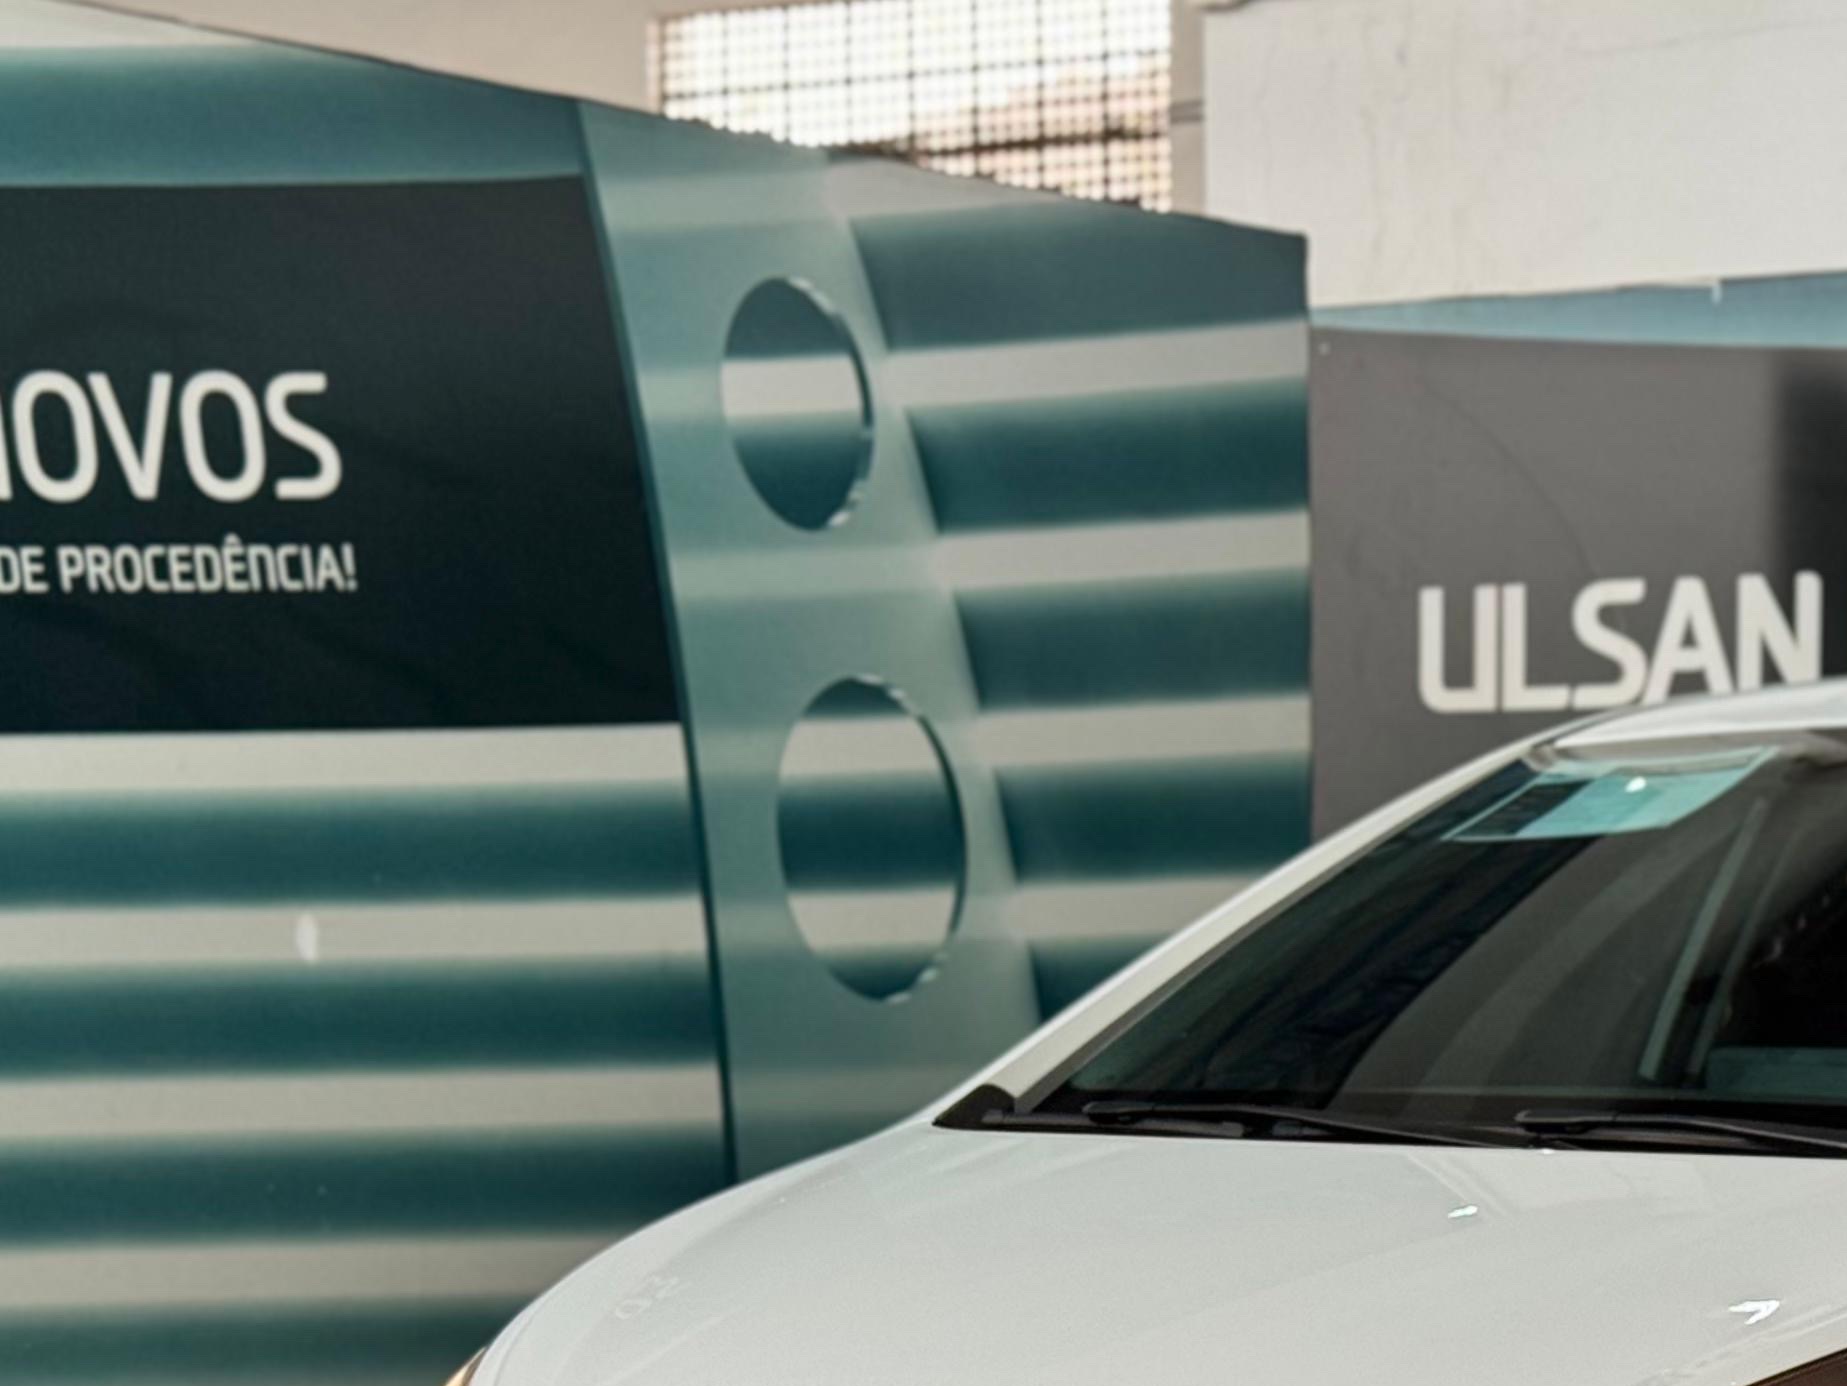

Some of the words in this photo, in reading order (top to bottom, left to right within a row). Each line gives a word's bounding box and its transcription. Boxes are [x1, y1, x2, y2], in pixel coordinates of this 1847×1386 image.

[0, 369, 342, 503] OVOS
[0, 545, 49, 594] DE
[57, 533, 358, 593] PROCEDÊNCIA!
[1418, 571, 1823, 713] ULSAN
